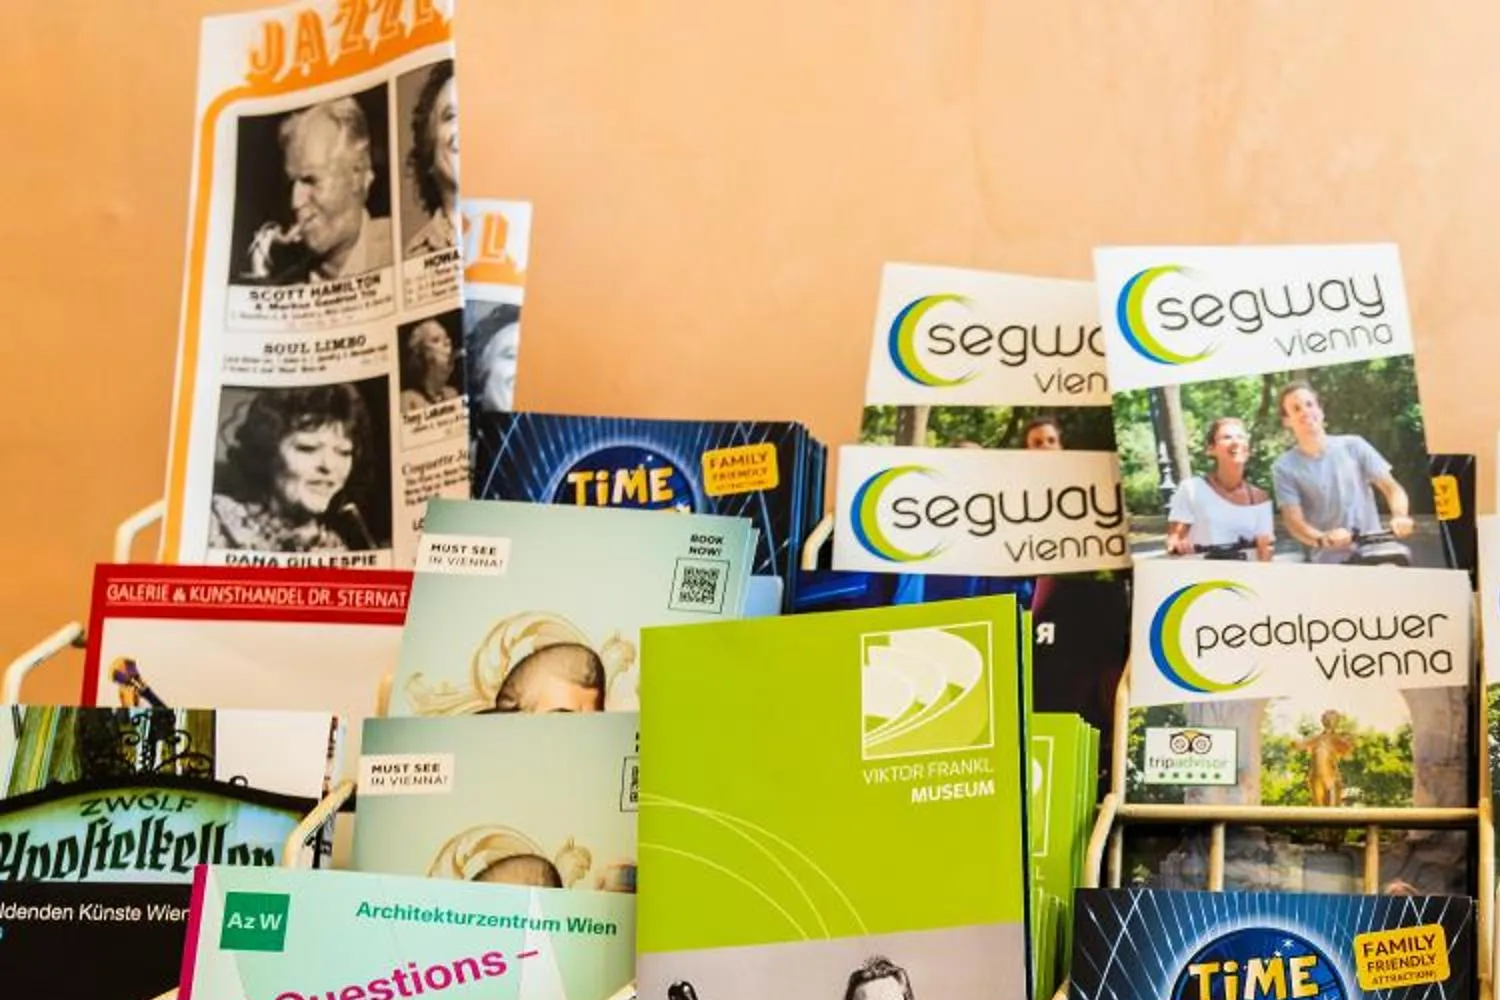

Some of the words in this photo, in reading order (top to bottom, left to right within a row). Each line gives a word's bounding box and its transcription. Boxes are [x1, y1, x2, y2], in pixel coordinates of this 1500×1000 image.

[1157, 272, 1386, 334] segway
[1273, 322, 1393, 358] vienna
[709, 451, 768, 469] FAMILY
[892, 483, 1124, 537] segway
[429, 556, 443, 566] IN
[431, 543, 469, 555] MUST
[472, 545, 497, 556] SEE
[1004, 534, 1127, 565] vienna
[106, 583, 169, 602] GALERIE
[172, 587, 187, 603] &
[189, 585, 304, 607] KUNSTHANDEL
[307, 591, 334, 607] DR.
[338, 591, 408, 609] STERNAT
[1195, 612, 1449, 658] pedalpower
[1315, 649, 1453, 681] vienna
[371, 764, 409, 774] MUST
[414, 763, 441, 774] SEE
[371, 775, 385, 786] IN
[863, 763, 924, 785] VIKTOR
[928, 757, 994, 778] FRANKL
[911, 780, 995, 804] MUSEUM
[79, 903, 142, 923] Künste
[356, 900, 560, 934] Architekturzentrum
[566, 917, 617, 936] Wien
[1362, 934, 1436, 958] FAMILY
[1366, 953, 1437, 973] FRIENDLY
